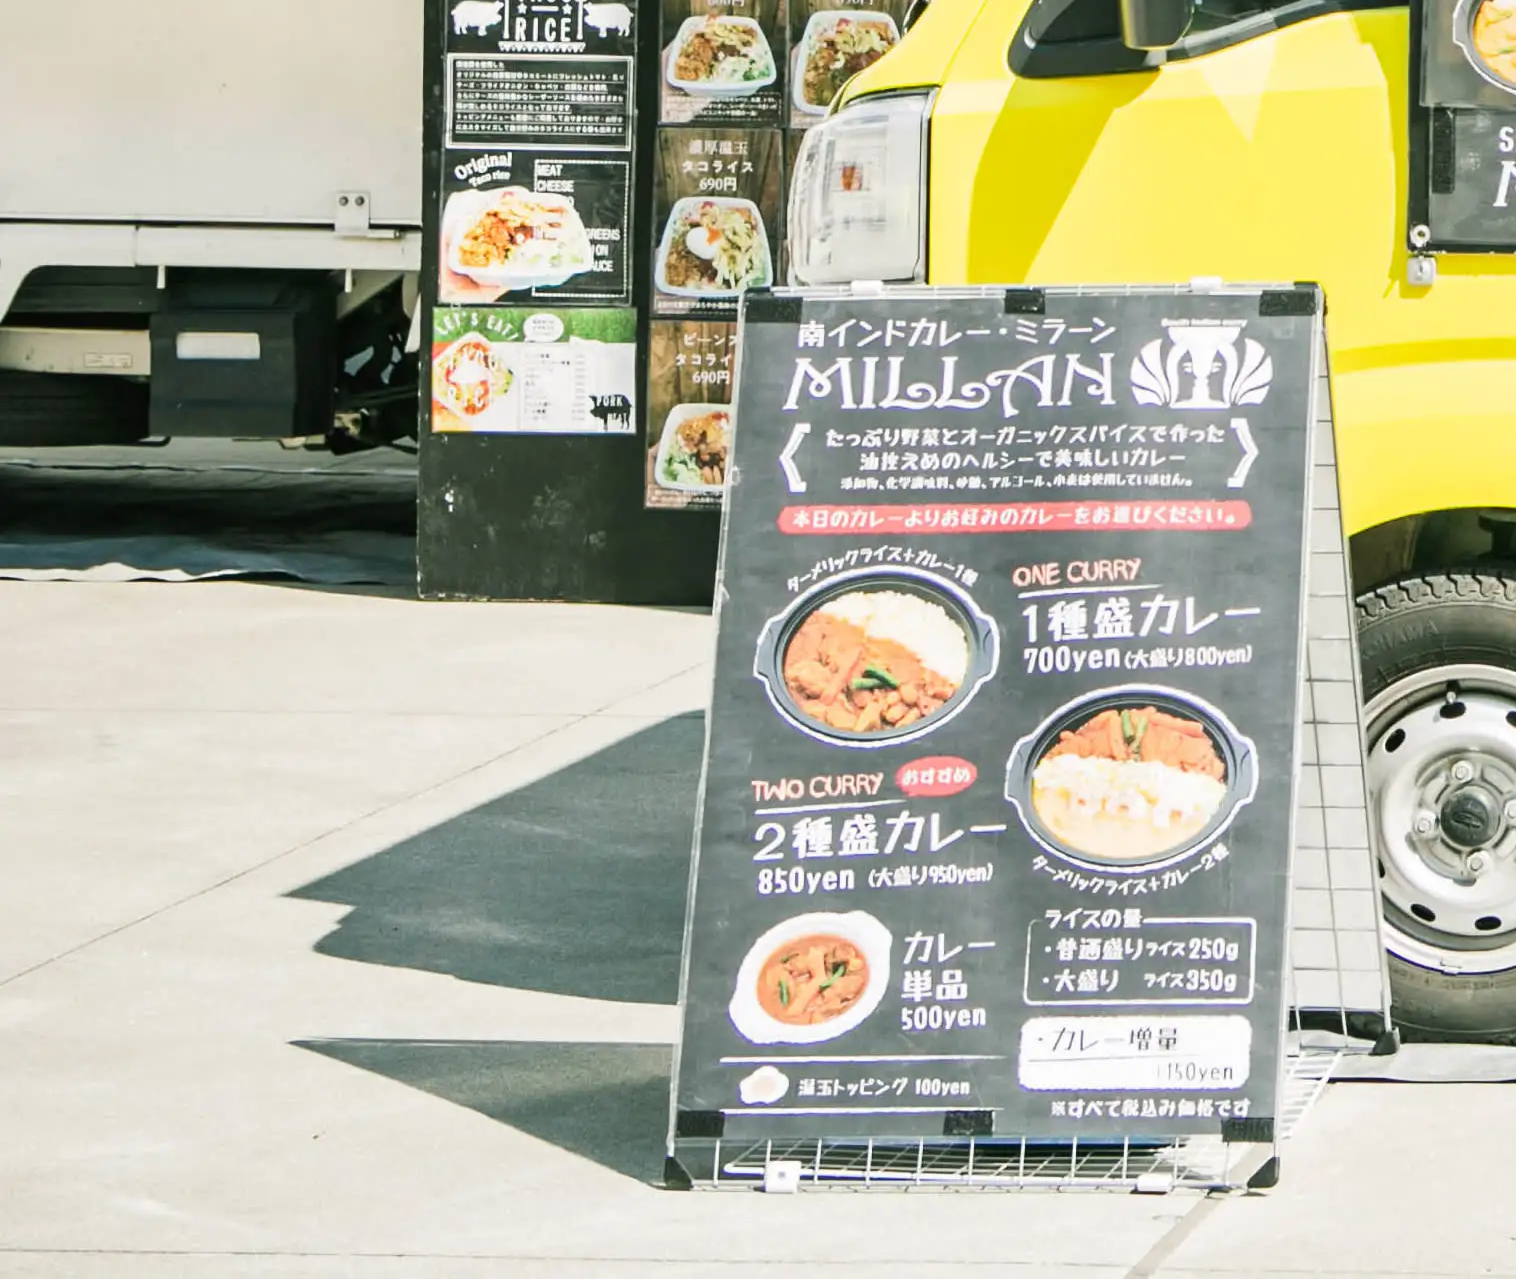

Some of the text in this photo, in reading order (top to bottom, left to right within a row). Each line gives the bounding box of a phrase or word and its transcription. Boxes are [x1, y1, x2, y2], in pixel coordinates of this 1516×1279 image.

[515, 17, 572, 42] RICE
[453, 151, 513, 181] Original
[682, 160, 754, 174] タコライス
[537, 180, 575, 192] CHEESE
[699, 176, 737, 192] 690円
[797, 316, 1117, 347] 南インドカレー・ミラーン
[675, 353, 732, 366] タコライ
[692, 371, 731, 385] 690円
[782, 352, 1117, 419] MILLAN
[825, 423, 1225, 449] たっぷり野菜とオーガニックスパイスで作った
[859, 449, 1187, 472] 油控えめのヘルシーで美味しいカレー
[792, 505, 1236, 530] 本日のカレーよりお好みのカレーをお選びください。
[1011, 557, 1142, 588] ONE CURRY
[1022, 592, 1262, 644] 1種盛カレー
[1023, 644, 1121, 674] 700yen
[751, 772, 884, 802] TWO CURRY
[902, 766, 971, 787] おすすめ
[752, 809, 1007, 862] 2種盛カレー
[757, 864, 855, 896] 850yen
[1044, 907, 1145, 929] ライスの量
[903, 931, 996, 965] カレー
[901, 969, 968, 1003] 単品
[901, 1004, 987, 1031] 500yen
[798, 1076, 971, 1097] 温玉トッピング 100yen
